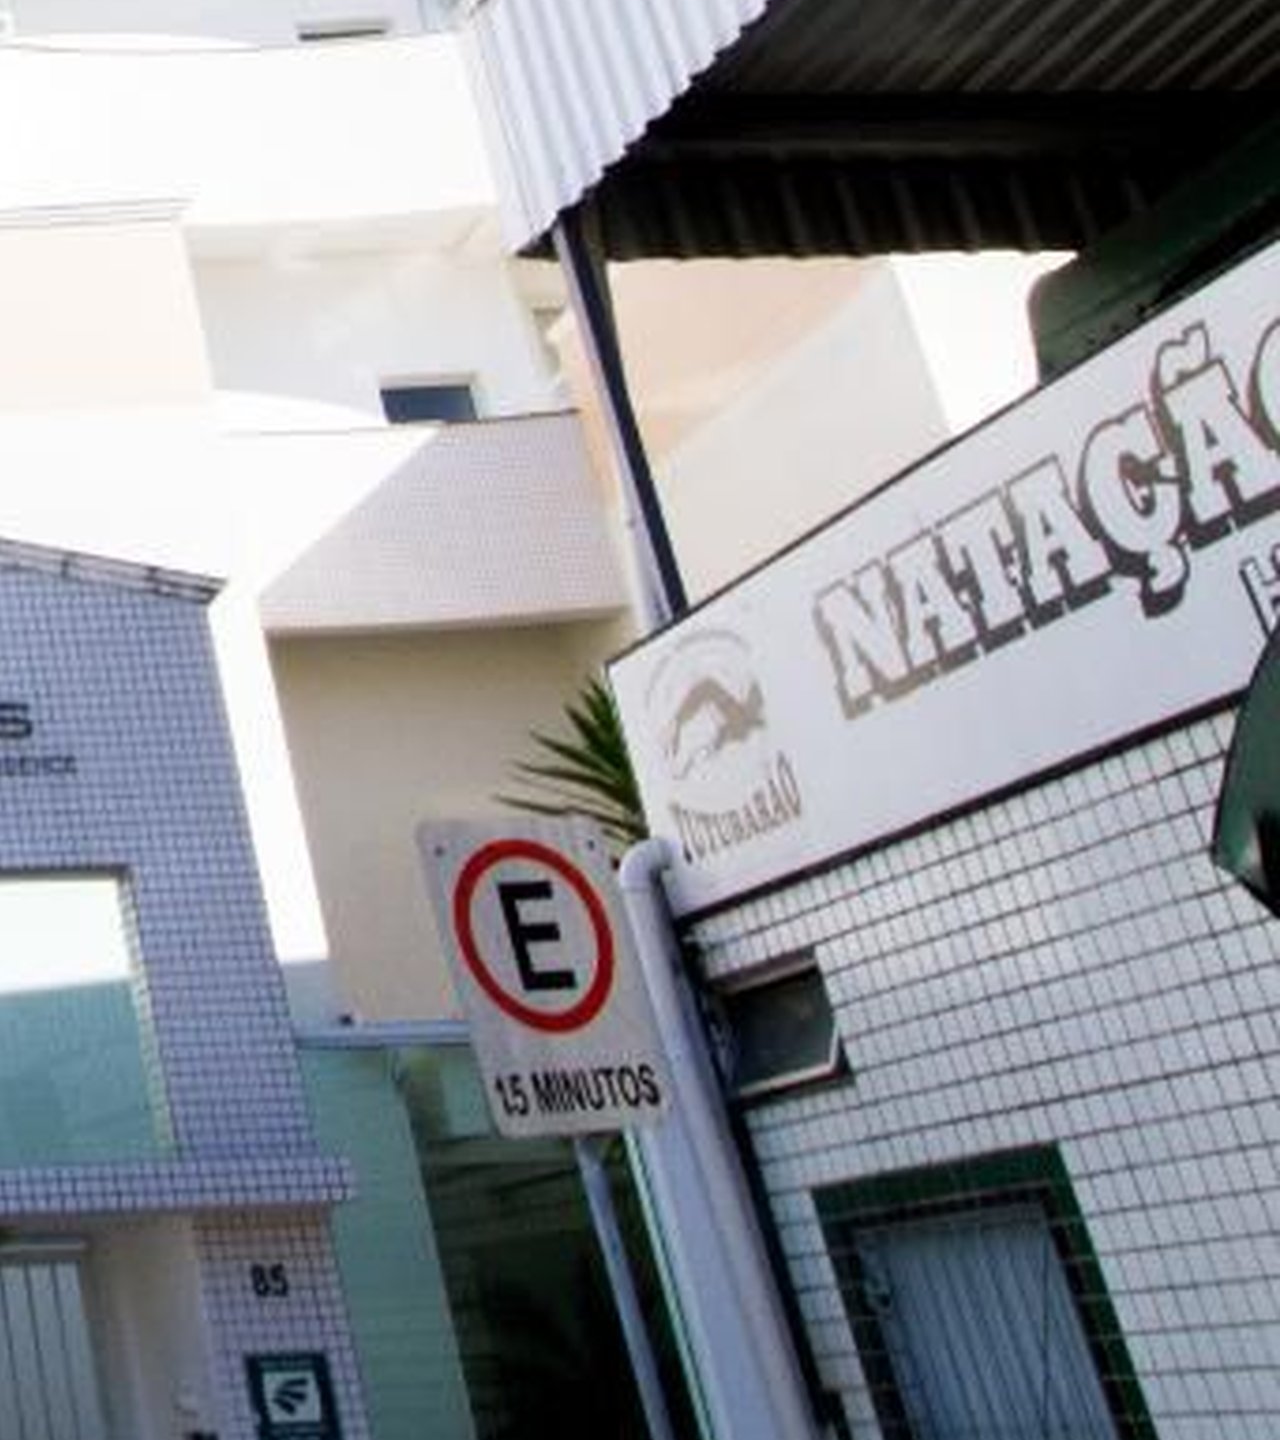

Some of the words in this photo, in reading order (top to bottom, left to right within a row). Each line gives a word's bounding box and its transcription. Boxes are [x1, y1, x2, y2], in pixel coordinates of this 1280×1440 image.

[498, 880, 577, 990] E
[495, 1074, 529, 1116] 15
[532, 1064, 660, 1112] MINUTOS
